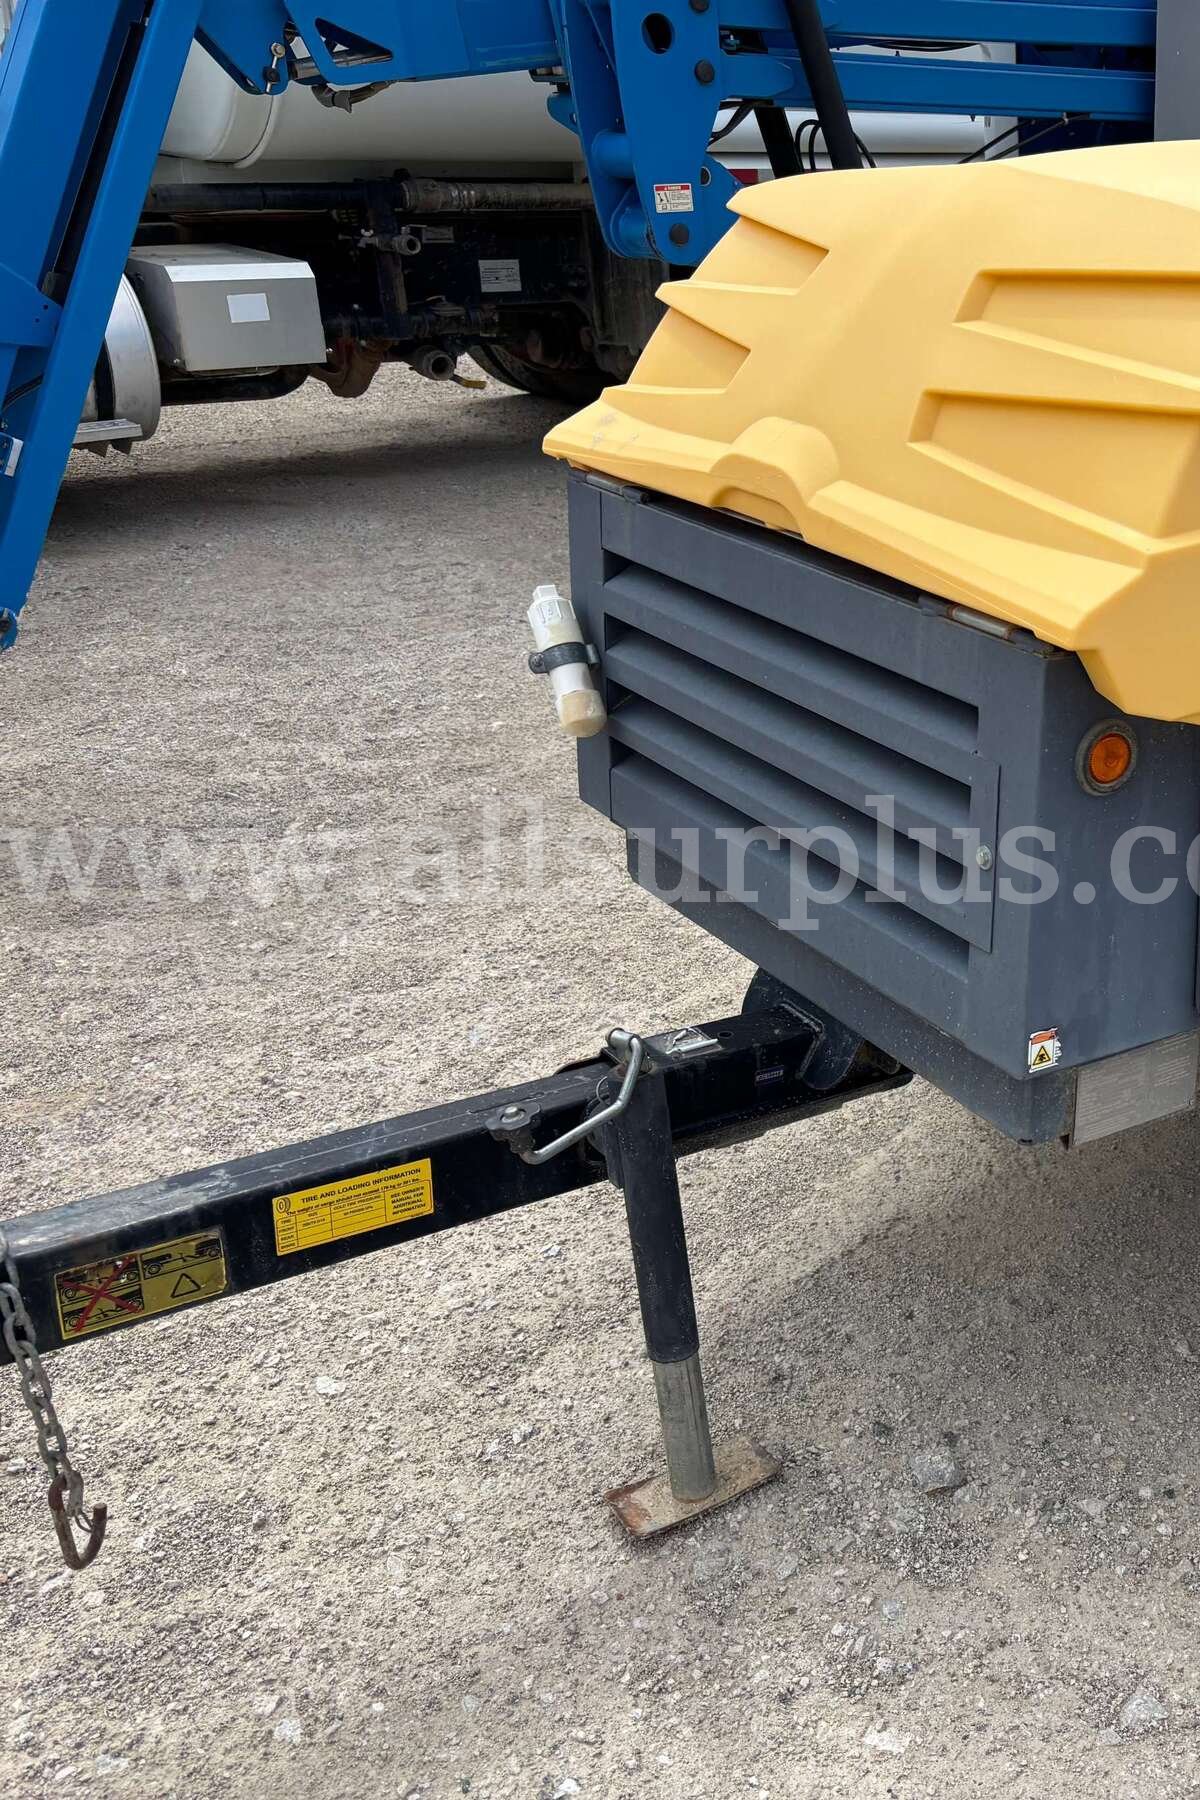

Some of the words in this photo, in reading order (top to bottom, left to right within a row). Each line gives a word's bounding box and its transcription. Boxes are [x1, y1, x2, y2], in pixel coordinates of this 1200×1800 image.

[301, 1194, 317, 1203] TIRE
[319, 1190, 334, 1198] AND
[337, 1180, 370, 1194] LOADING
[372, 1167, 420, 1185] INFORMATION
